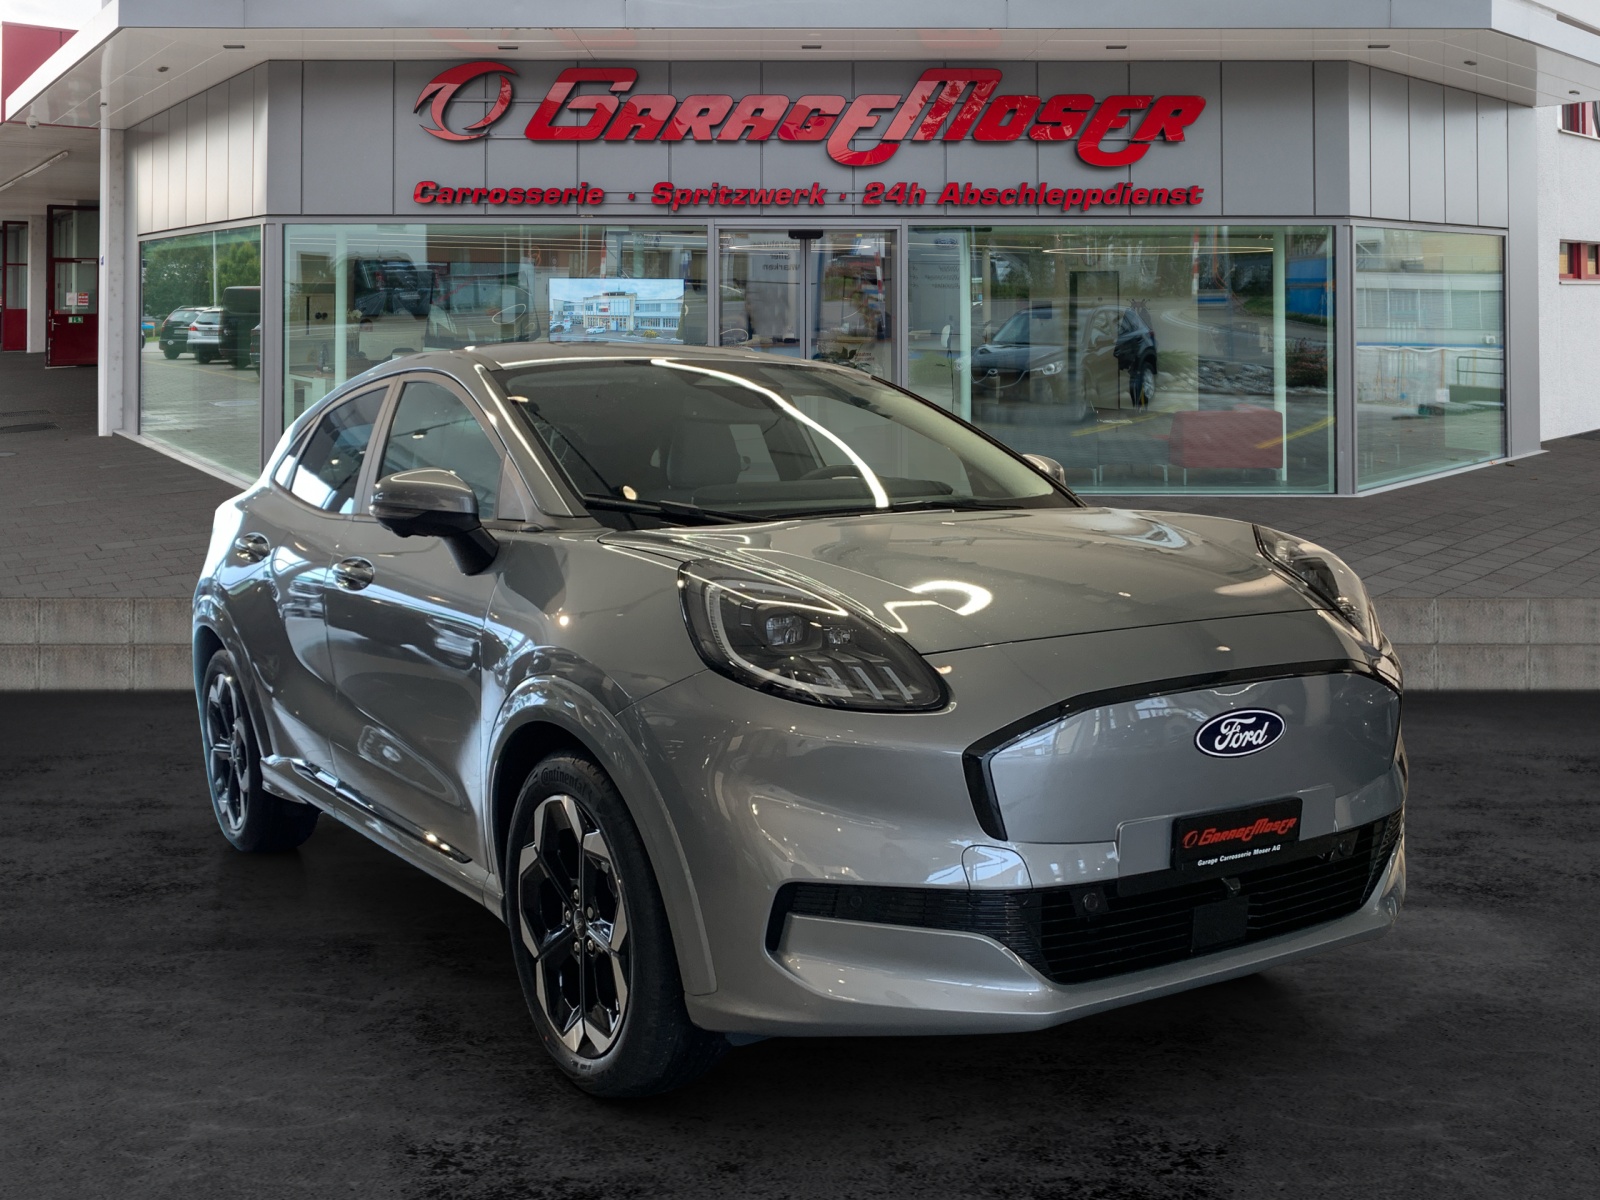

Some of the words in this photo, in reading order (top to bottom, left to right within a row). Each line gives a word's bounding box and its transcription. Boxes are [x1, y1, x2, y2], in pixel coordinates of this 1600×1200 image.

[413, 181, 604, 205] Carrosserie
[651, 182, 826, 211] Spritzwerk
[862, 182, 926, 205] 24h
[937, 182, 1204, 211] Abschleppdienst
[1214, 717, 1270, 751] Ford
[541, 766, 587, 796] Continental
[1197, 858, 1218, 867] Garage
[1219, 850, 1252, 862] Carrosserie
[1253, 846, 1271, 856] Moser
[1271, 844, 1282, 852] AG
